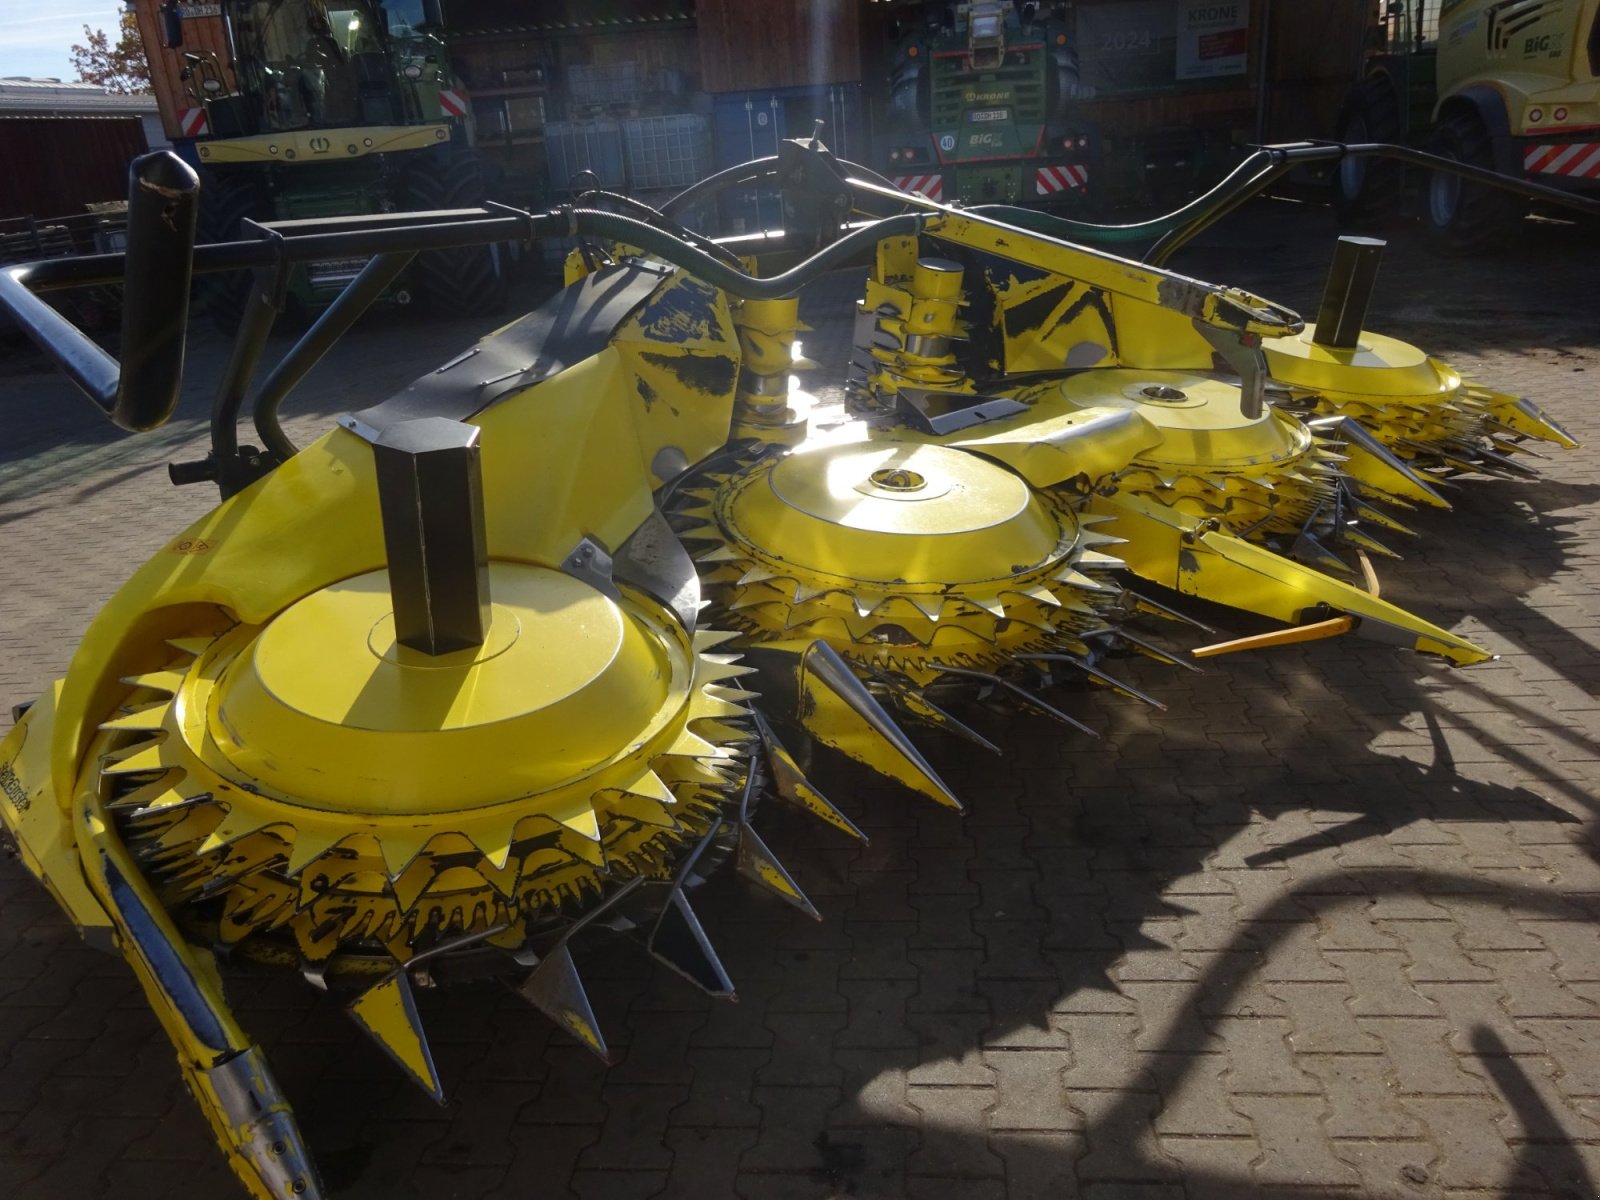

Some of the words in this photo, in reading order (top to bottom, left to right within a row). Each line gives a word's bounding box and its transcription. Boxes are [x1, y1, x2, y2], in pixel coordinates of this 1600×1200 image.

[1187, 6, 1240, 22] KRONE
[1523, 34, 1551, 54] BiG
[942, 137, 953, 149] 40
[969, 133, 993, 145] BiG
